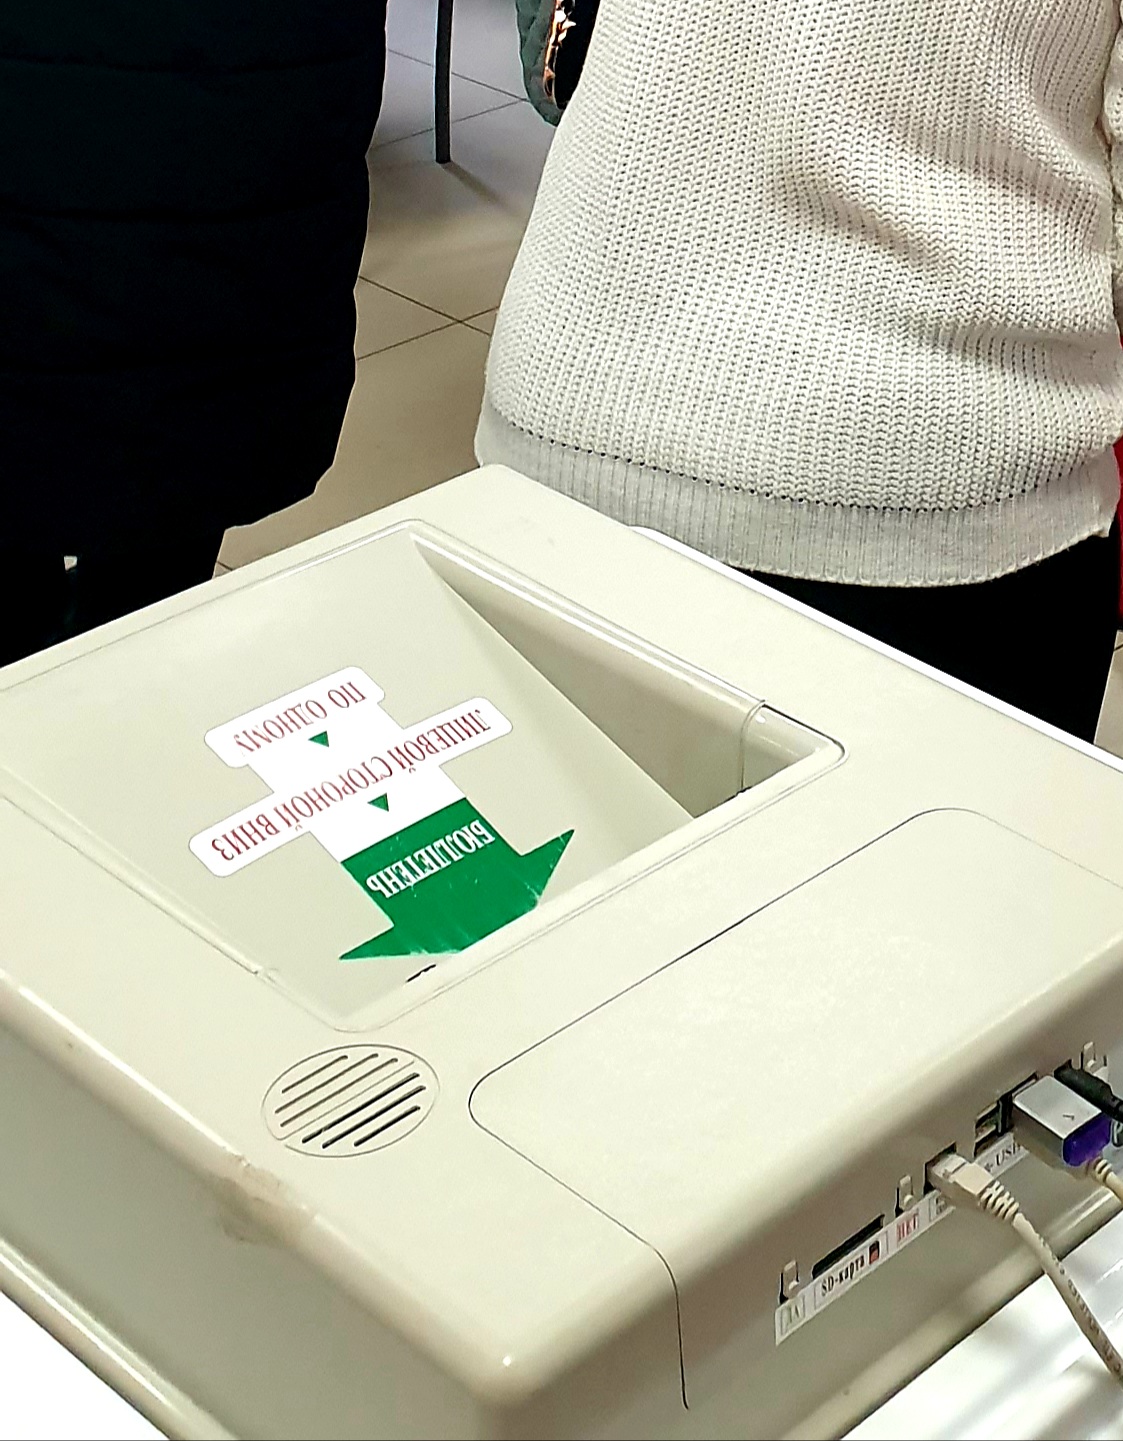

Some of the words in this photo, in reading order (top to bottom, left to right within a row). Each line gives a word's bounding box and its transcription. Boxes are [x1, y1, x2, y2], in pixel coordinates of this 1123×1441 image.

[327, 681, 367, 709] ПО
[233, 698, 328, 756] ОДНОМУ
[387, 708, 491, 774] ЛИЦЕВОЙ
[273, 756, 394, 831] СТОРОНОЙ
[210, 813, 281, 862] ВНИЗ
[365, 819, 496, 899] БЮЛЛЕТЕНЬ
[821, 1255, 865, 1297] SD-карта
